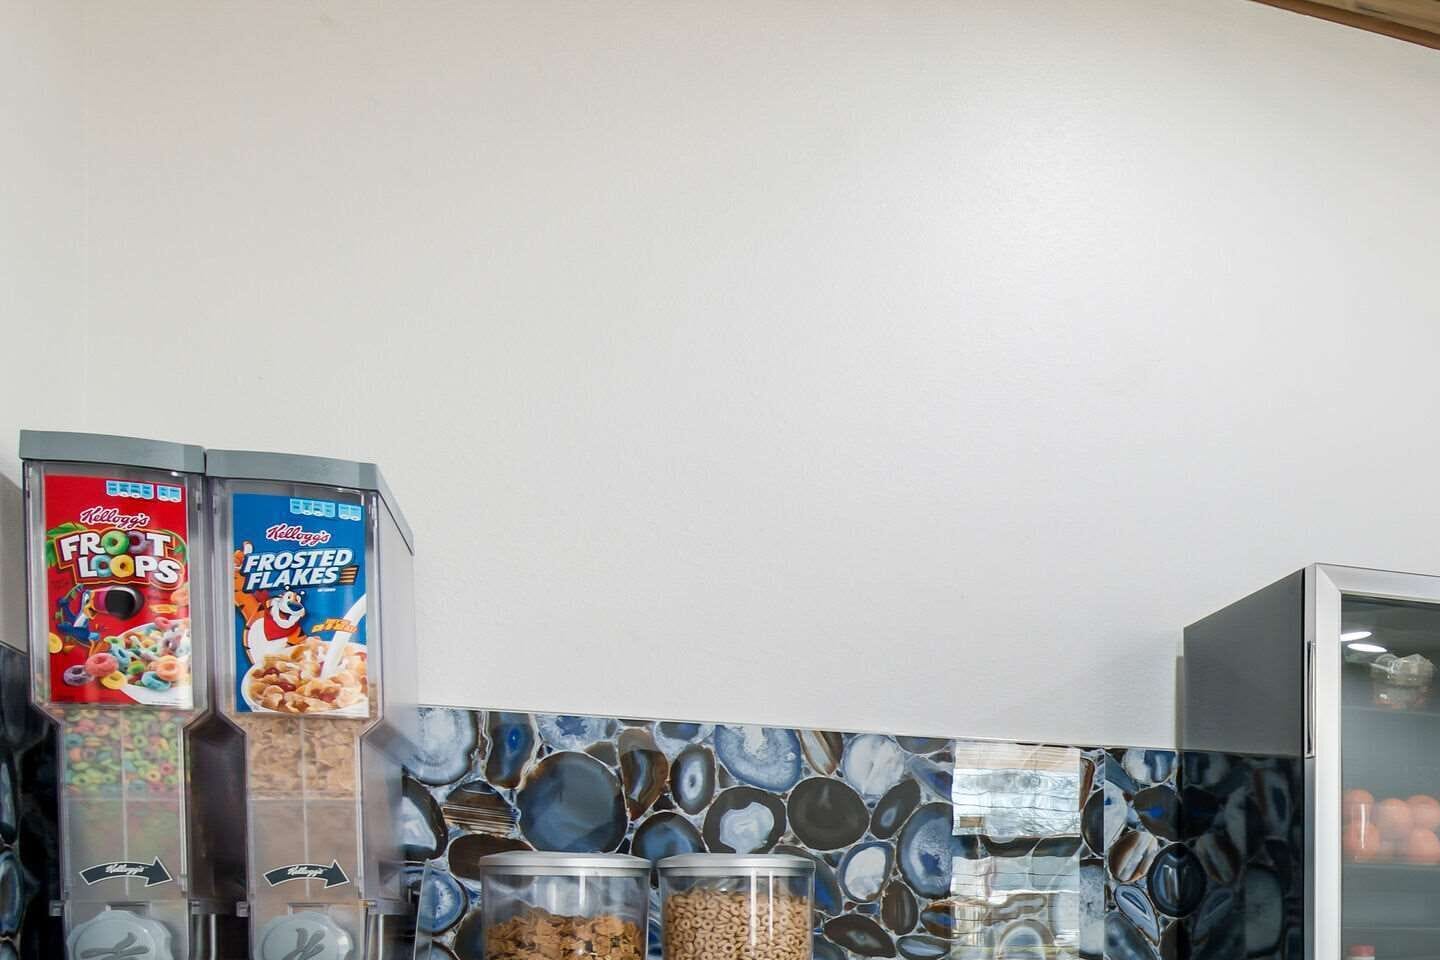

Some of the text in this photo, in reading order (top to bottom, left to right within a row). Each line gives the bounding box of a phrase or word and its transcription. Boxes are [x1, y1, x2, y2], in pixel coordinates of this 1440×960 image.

[81, 506, 150, 529] Kellogg's
[60, 531, 170, 561] FROOT
[266, 523, 331, 546] Kellogg's
[78, 555, 181, 584] LOOPS
[243, 549, 353, 573] FROSTED
[246, 566, 340, 591] FLAKES
